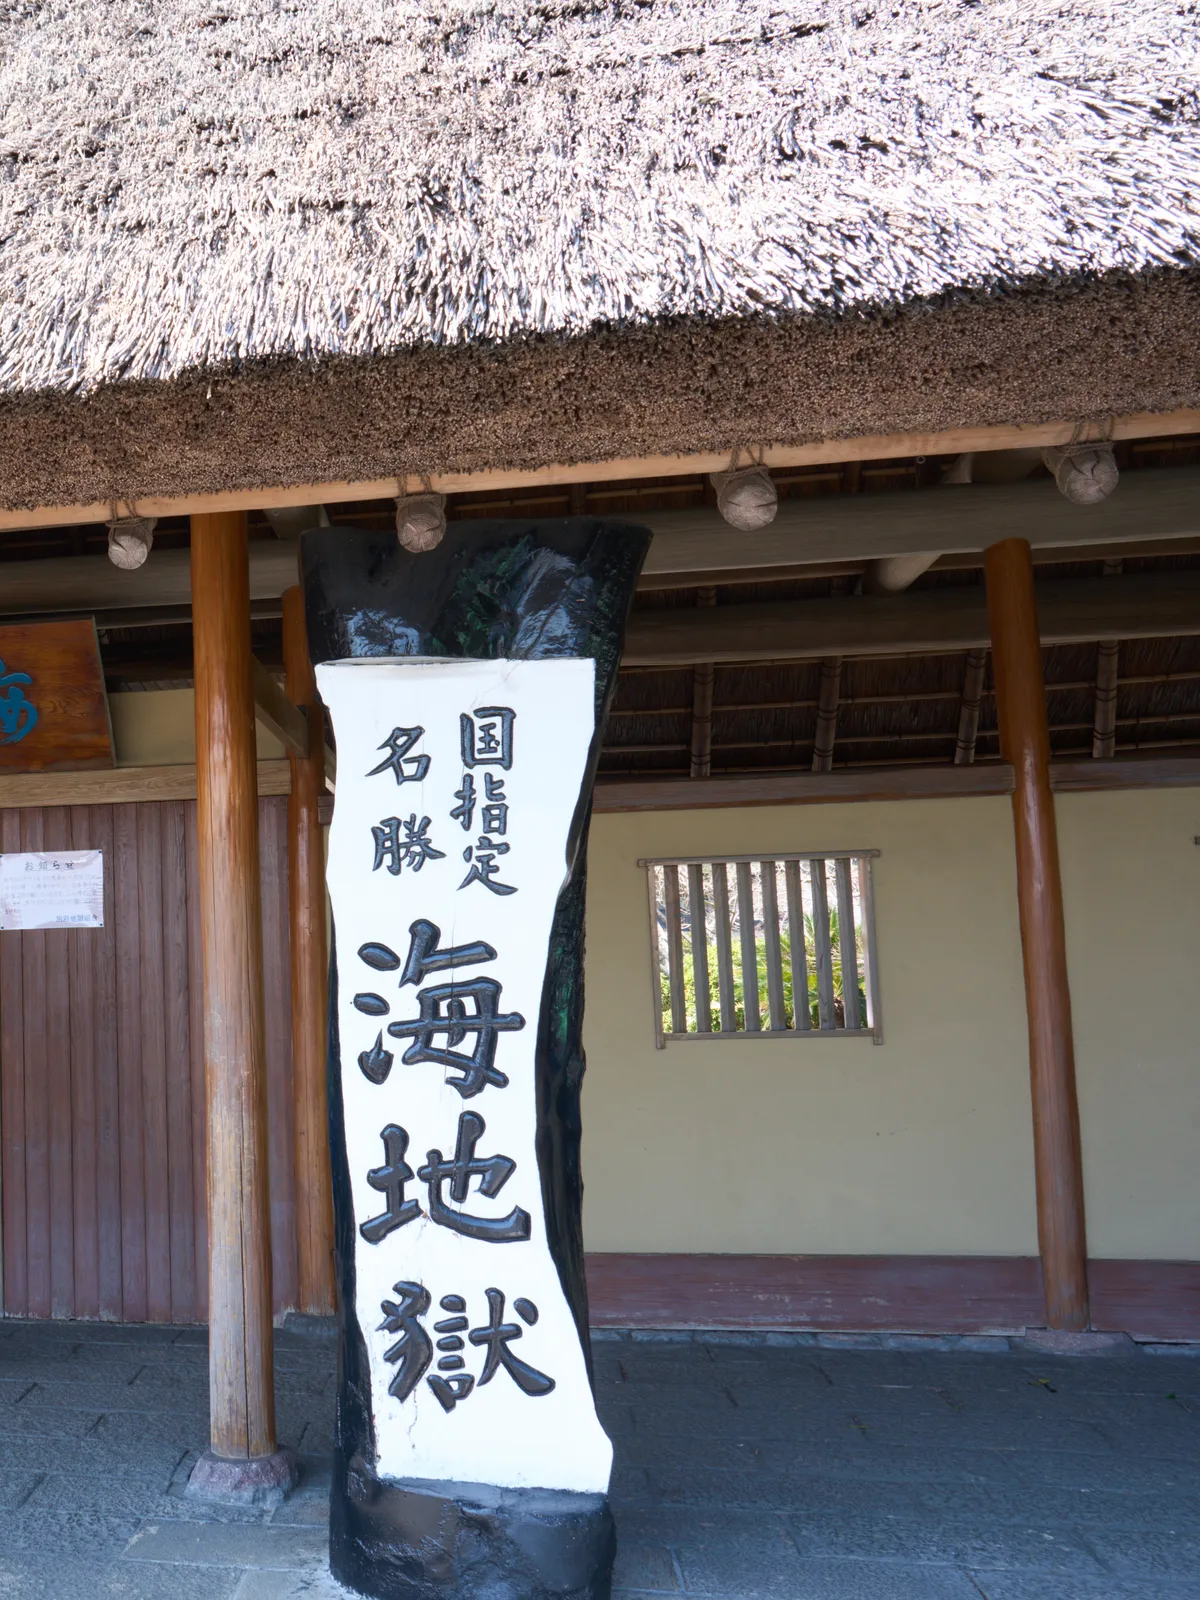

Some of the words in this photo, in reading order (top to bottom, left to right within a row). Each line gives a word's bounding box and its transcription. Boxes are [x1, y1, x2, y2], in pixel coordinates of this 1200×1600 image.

[24, 860, 76, 871] お知らせ
[365, 725, 447, 876] 名勝
[450, 706, 518, 896] 国指定
[353, 918, 556, 1414] 海地獄
